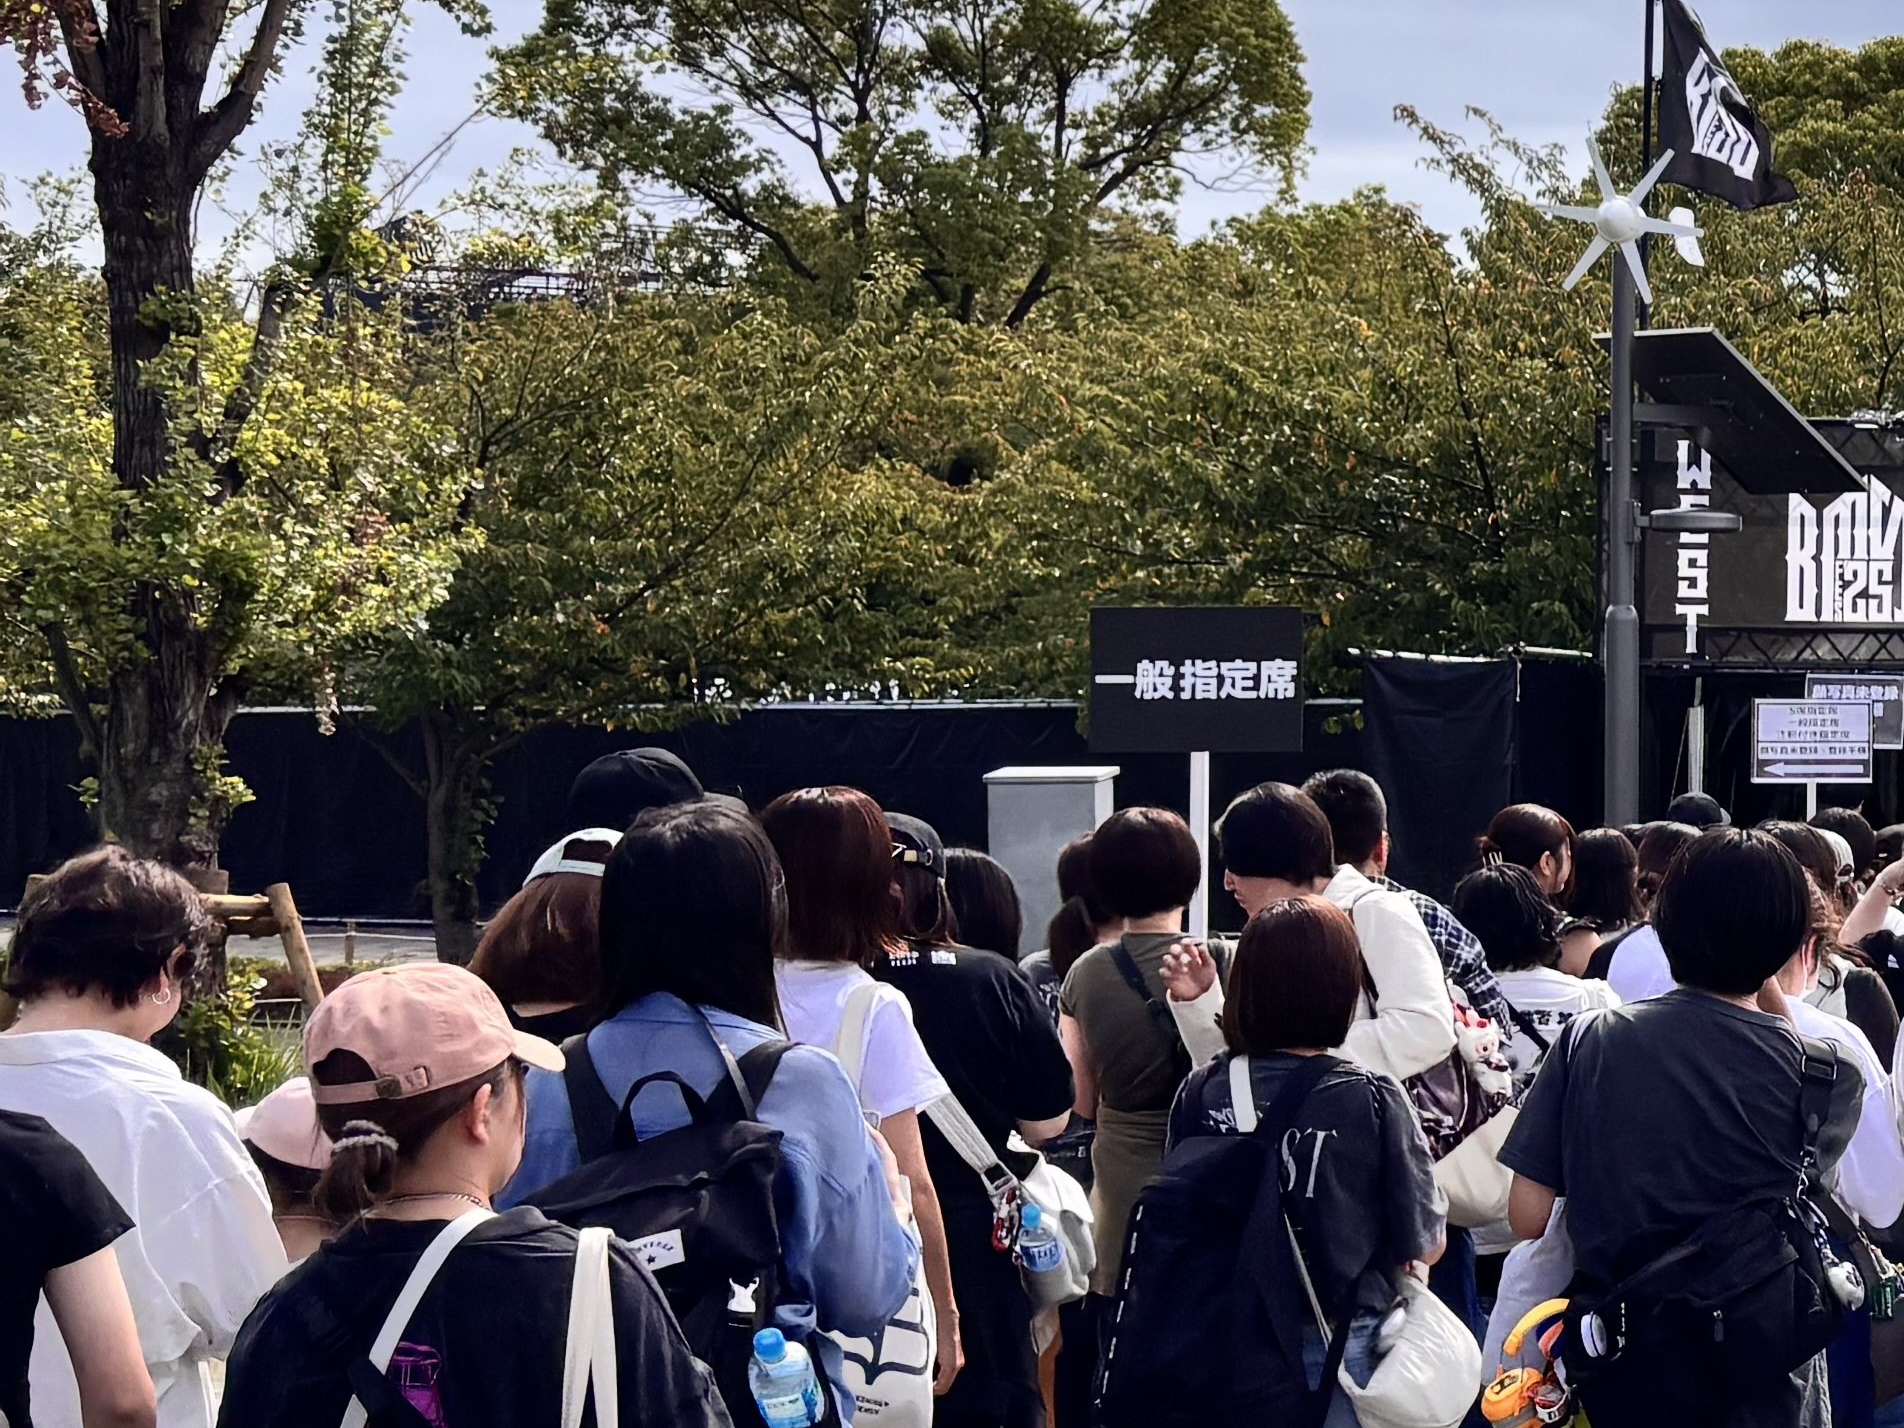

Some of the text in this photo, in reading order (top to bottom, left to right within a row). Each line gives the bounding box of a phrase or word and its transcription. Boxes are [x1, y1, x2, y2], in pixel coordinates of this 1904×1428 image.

[1095, 658, 1299, 701] 一般指定席
